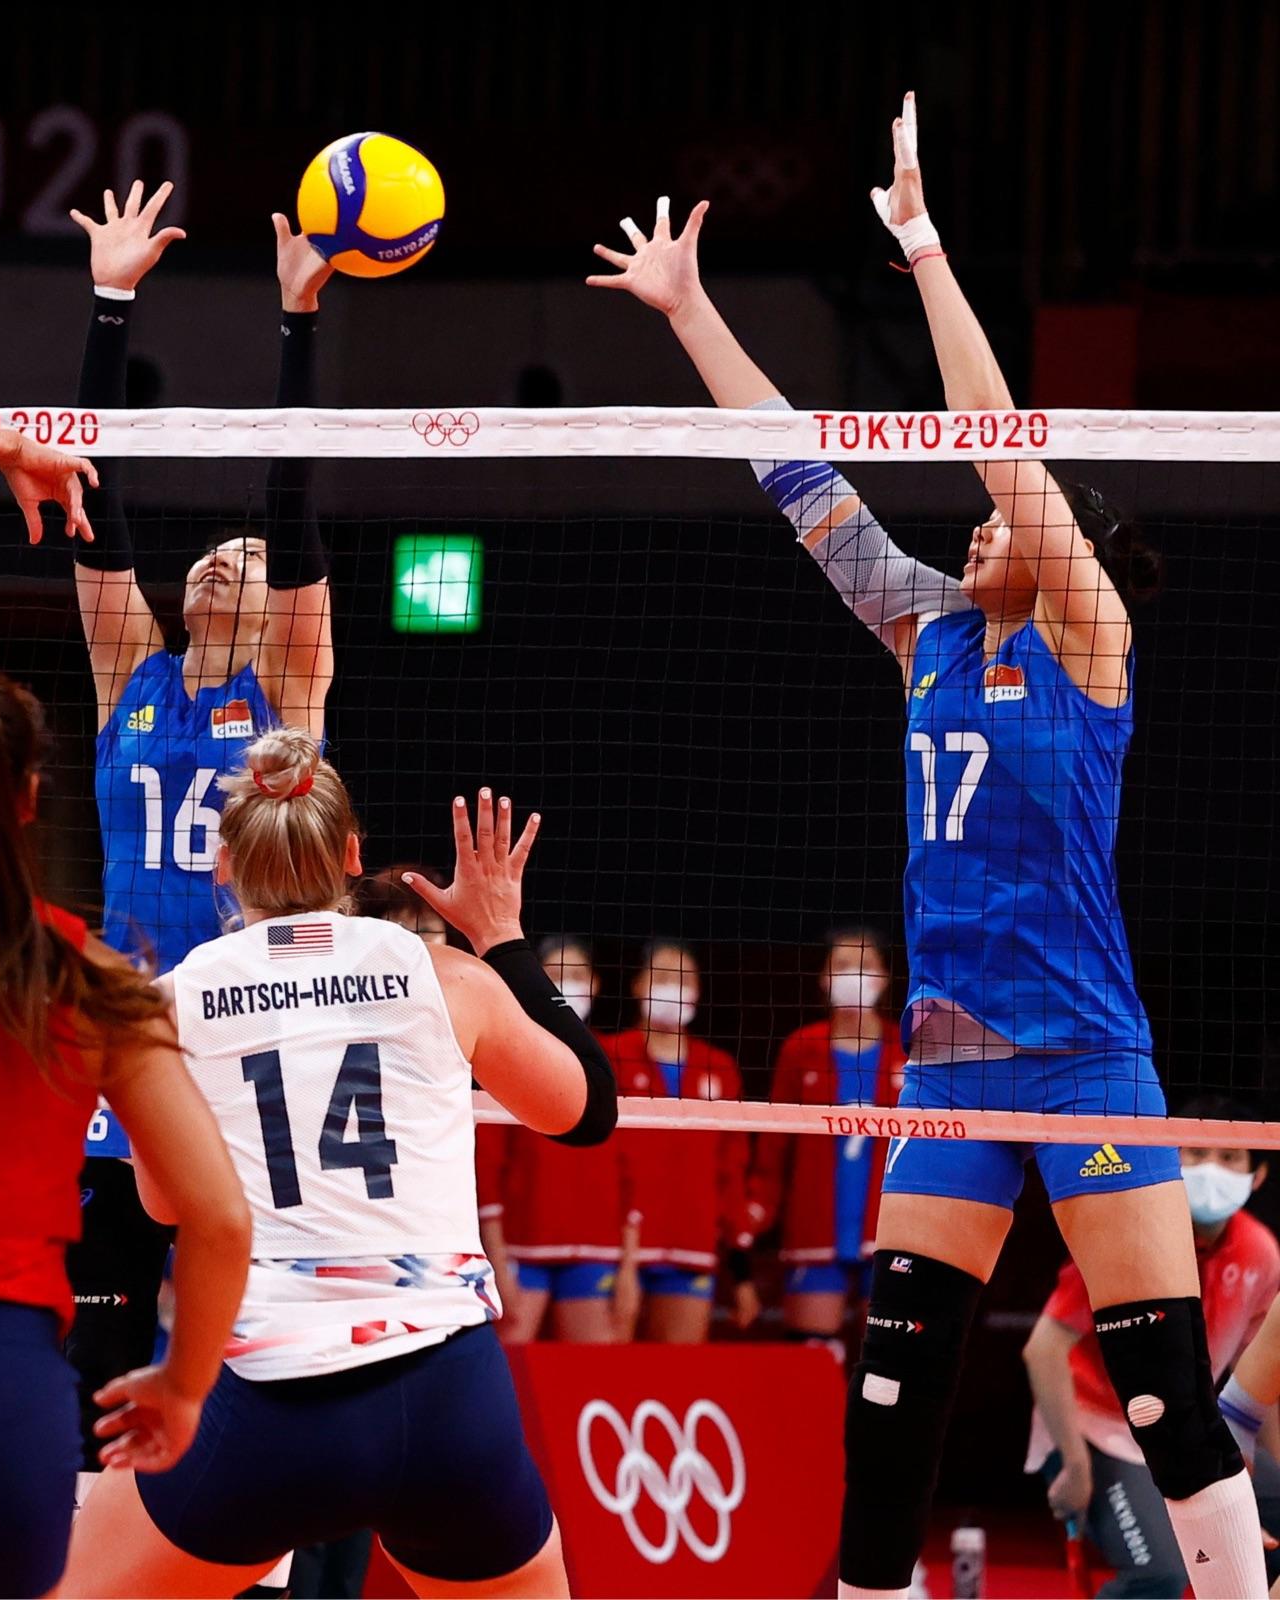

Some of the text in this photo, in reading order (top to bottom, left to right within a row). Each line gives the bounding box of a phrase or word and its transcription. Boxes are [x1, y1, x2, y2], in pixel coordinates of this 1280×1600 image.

[378, 241, 417, 260] TOKYO
[11, 411, 98, 445] 2020
[813, 412, 1048, 449] TOKYO 2020
[990, 689, 1022, 698] CHN
[217, 724, 249, 735] CHN
[910, 732, 989, 841] 17
[131, 764, 220, 872] 16
[202, 975, 410, 1020] BARTSCH-HACKLEY
[241, 1043, 398, 1209] 14
[821, 1116, 966, 1139] TOKYO 2020
[1080, 1163, 1132, 1177] adidas
